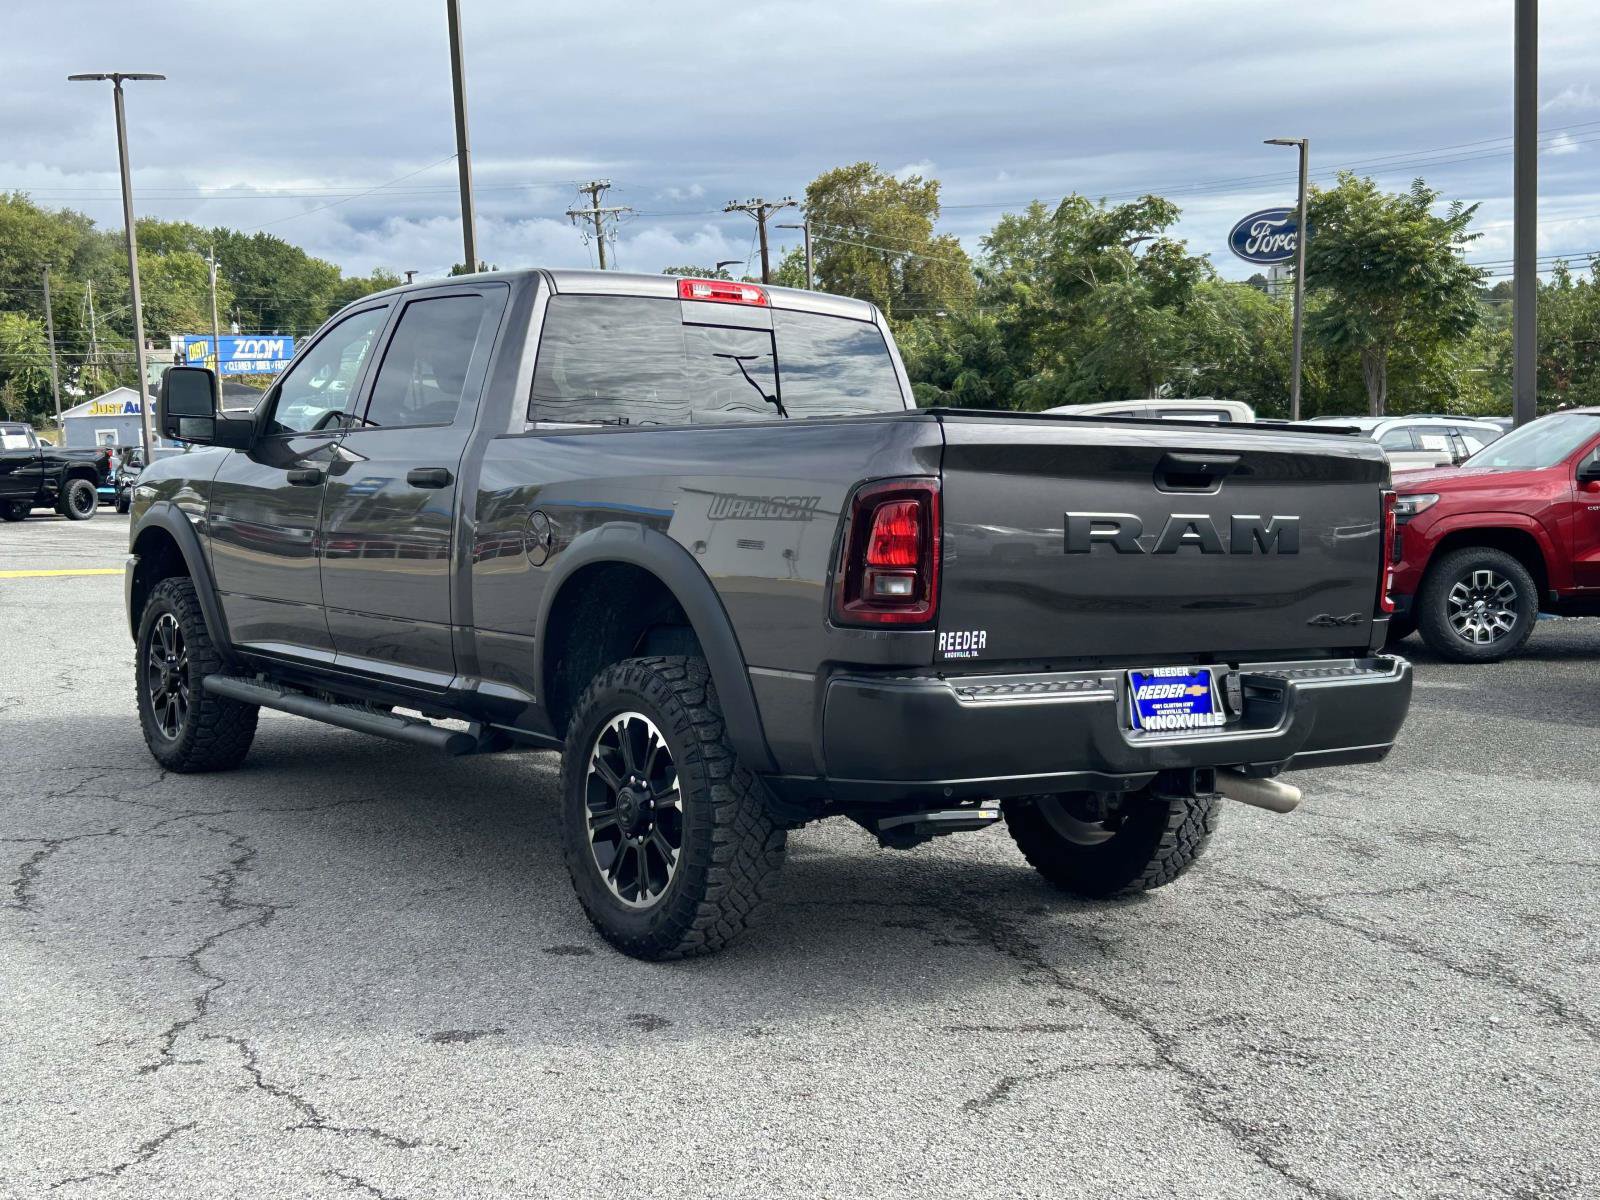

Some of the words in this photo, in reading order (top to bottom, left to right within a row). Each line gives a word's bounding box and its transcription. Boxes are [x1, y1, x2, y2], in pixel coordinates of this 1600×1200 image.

[188, 340, 208, 361] DIRTY
[232, 339, 284, 359] ZOOM
[1064, 511, 1300, 554] RAM
[938, 630, 987, 651] REEDER
[1153, 667, 1189, 677] REEDER
[1137, 684, 1186, 700] REEDER
[1146, 713, 1225, 730] KNOXVILLE
